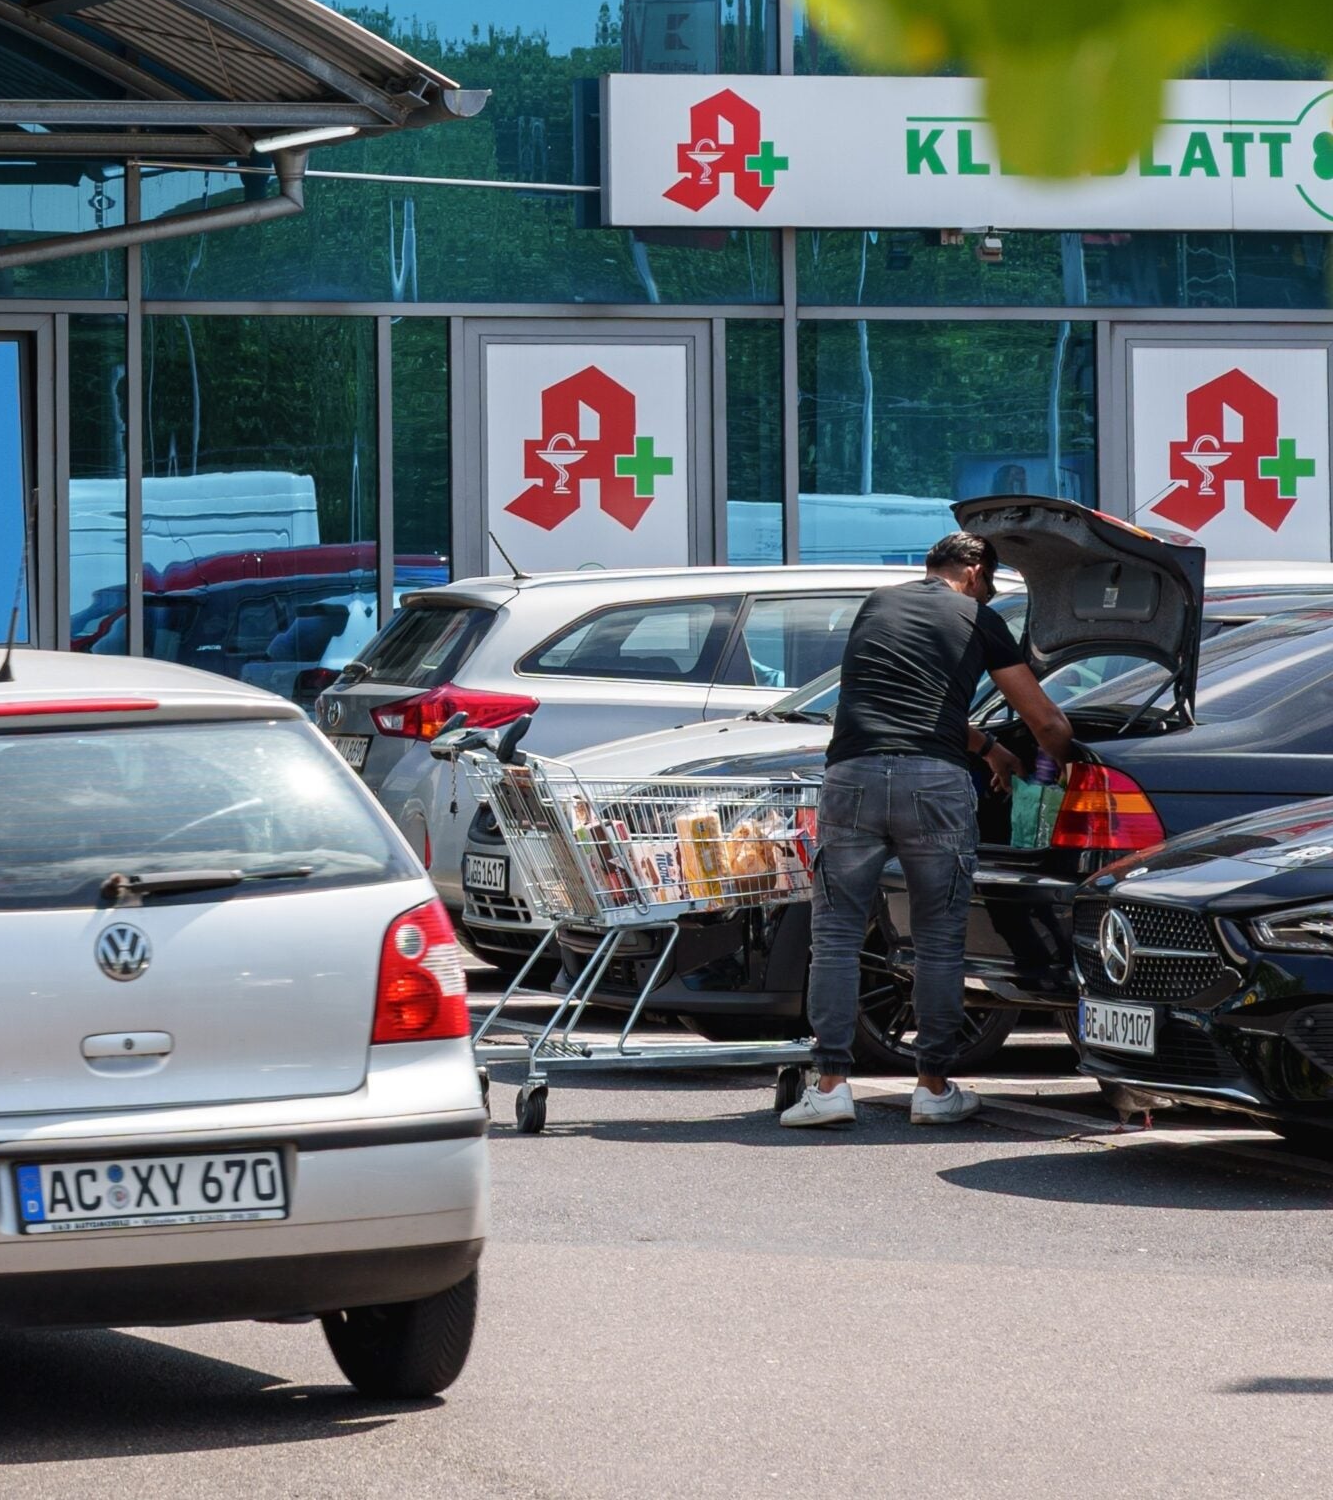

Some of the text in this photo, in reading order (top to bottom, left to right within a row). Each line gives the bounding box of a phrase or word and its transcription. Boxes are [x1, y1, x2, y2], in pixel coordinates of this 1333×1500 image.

[906, 128, 1292, 178] KLLATT
[1085, 1006, 1151, 1046] BE LR 9107
[49, 1158, 277, 1213] AC XY 670
